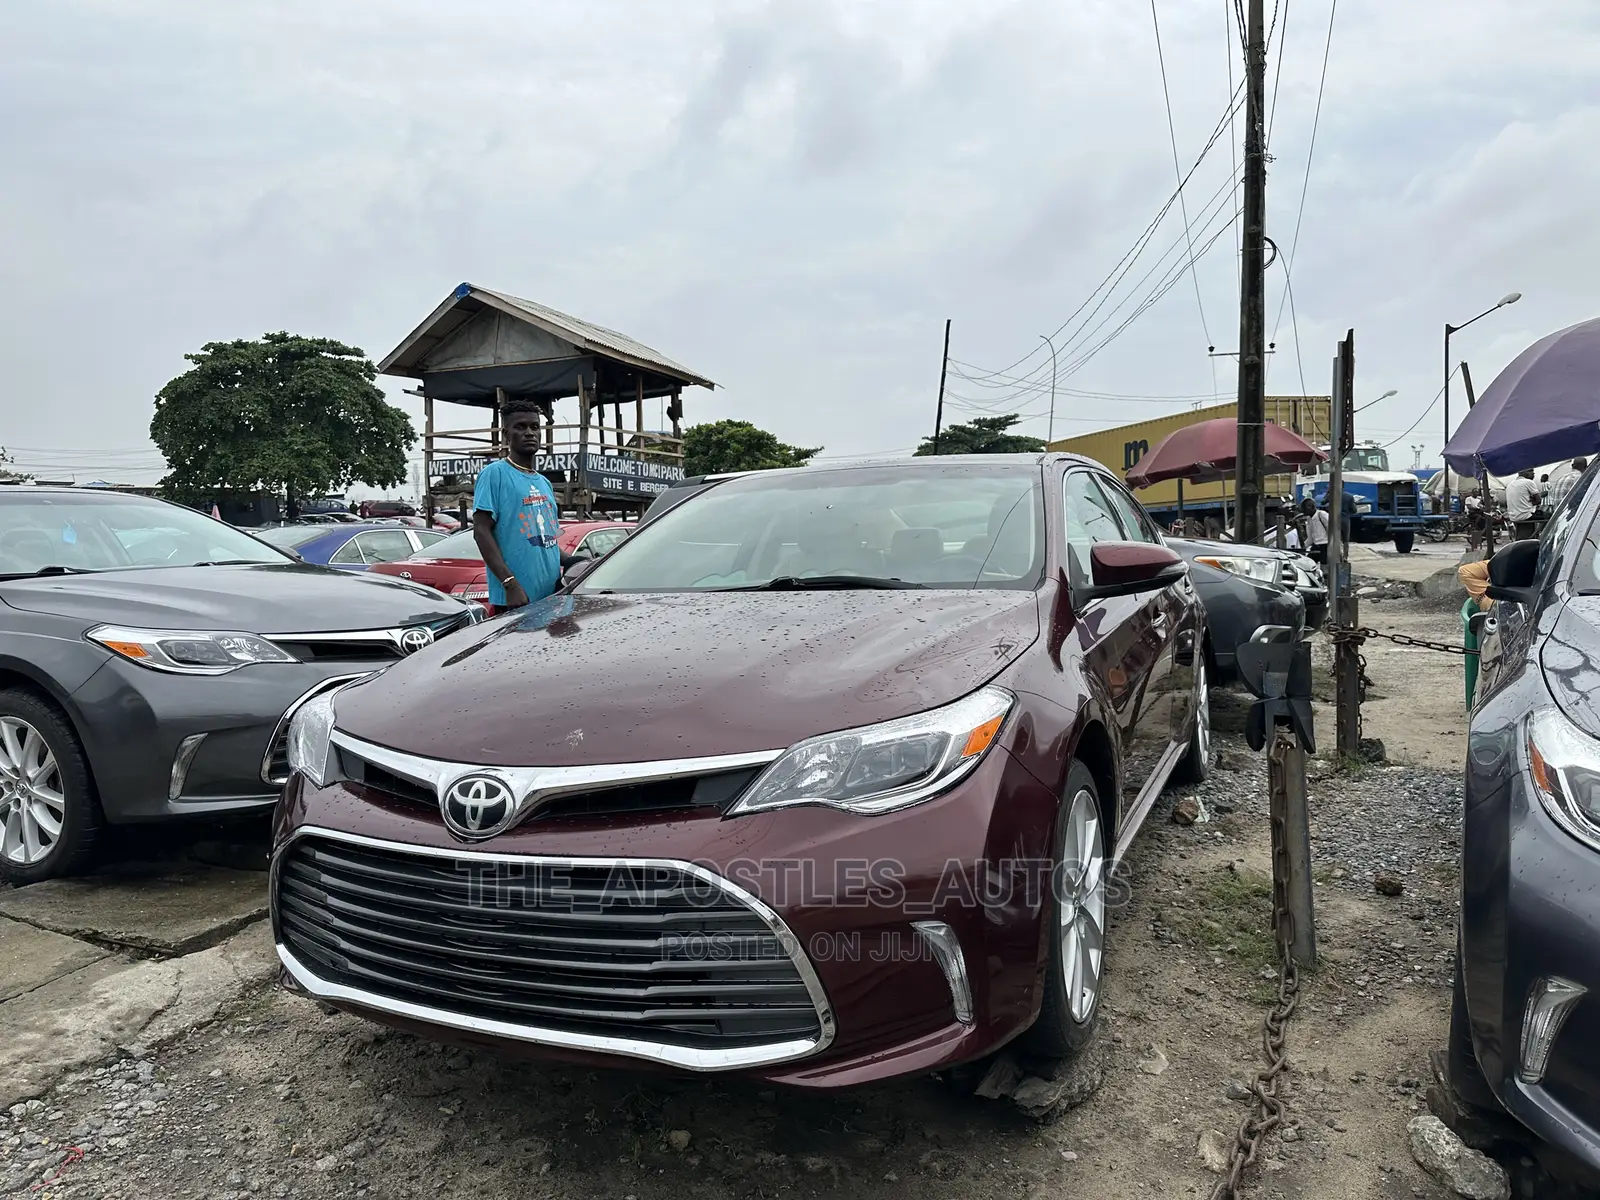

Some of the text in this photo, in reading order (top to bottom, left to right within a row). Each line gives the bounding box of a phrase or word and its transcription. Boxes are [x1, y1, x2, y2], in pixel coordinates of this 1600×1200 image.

[535, 454, 579, 471] PARK
[588, 454, 636, 475] WELCOME
[636, 461, 649, 477] TO
[661, 465, 686, 481] PARK
[602, 477, 622, 490] SITE
